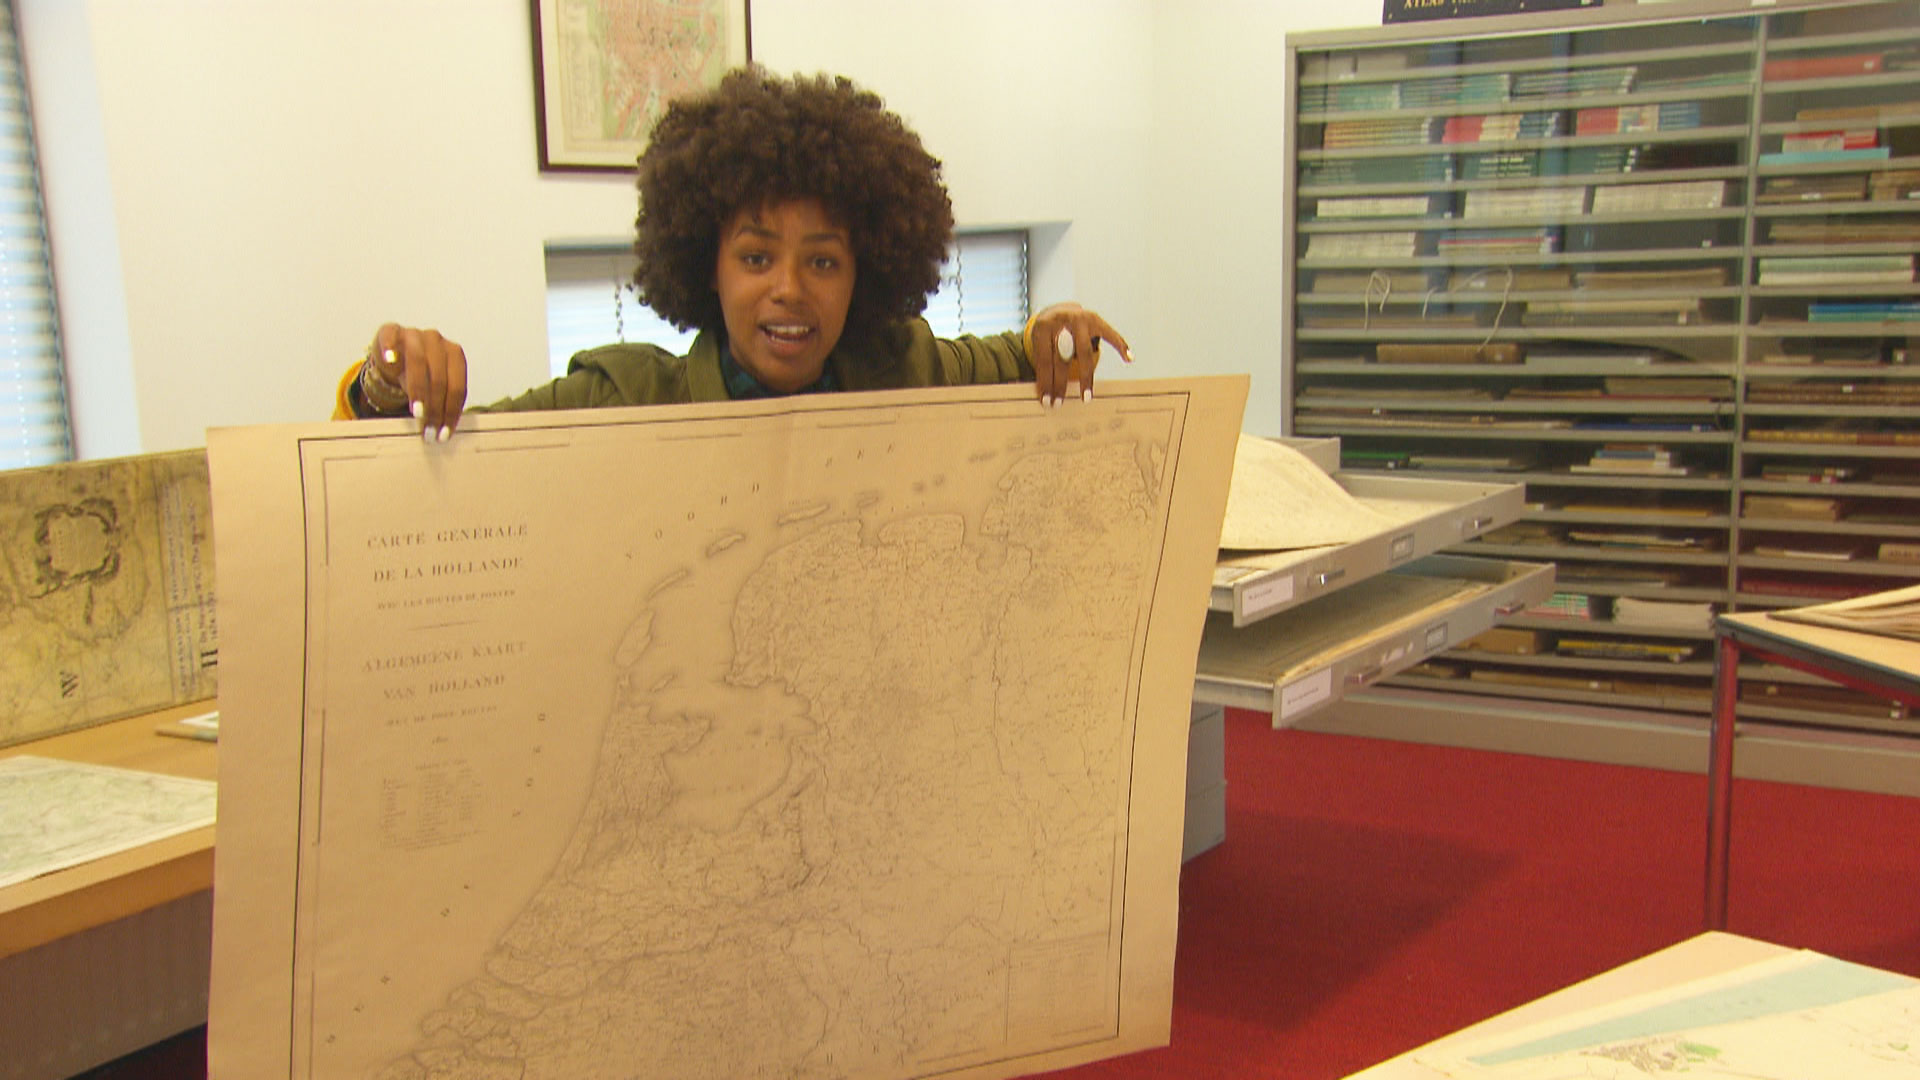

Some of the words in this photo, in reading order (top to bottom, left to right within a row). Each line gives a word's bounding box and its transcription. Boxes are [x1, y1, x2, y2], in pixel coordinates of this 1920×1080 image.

[367, 532, 425, 548] CARTE
[374, 569, 395, 582] DE
[404, 567, 423, 579] LA
[432, 557, 523, 576] HOLLANDE
[383, 687, 415, 699] VAN
[429, 675, 505, 694] HOLLAND
